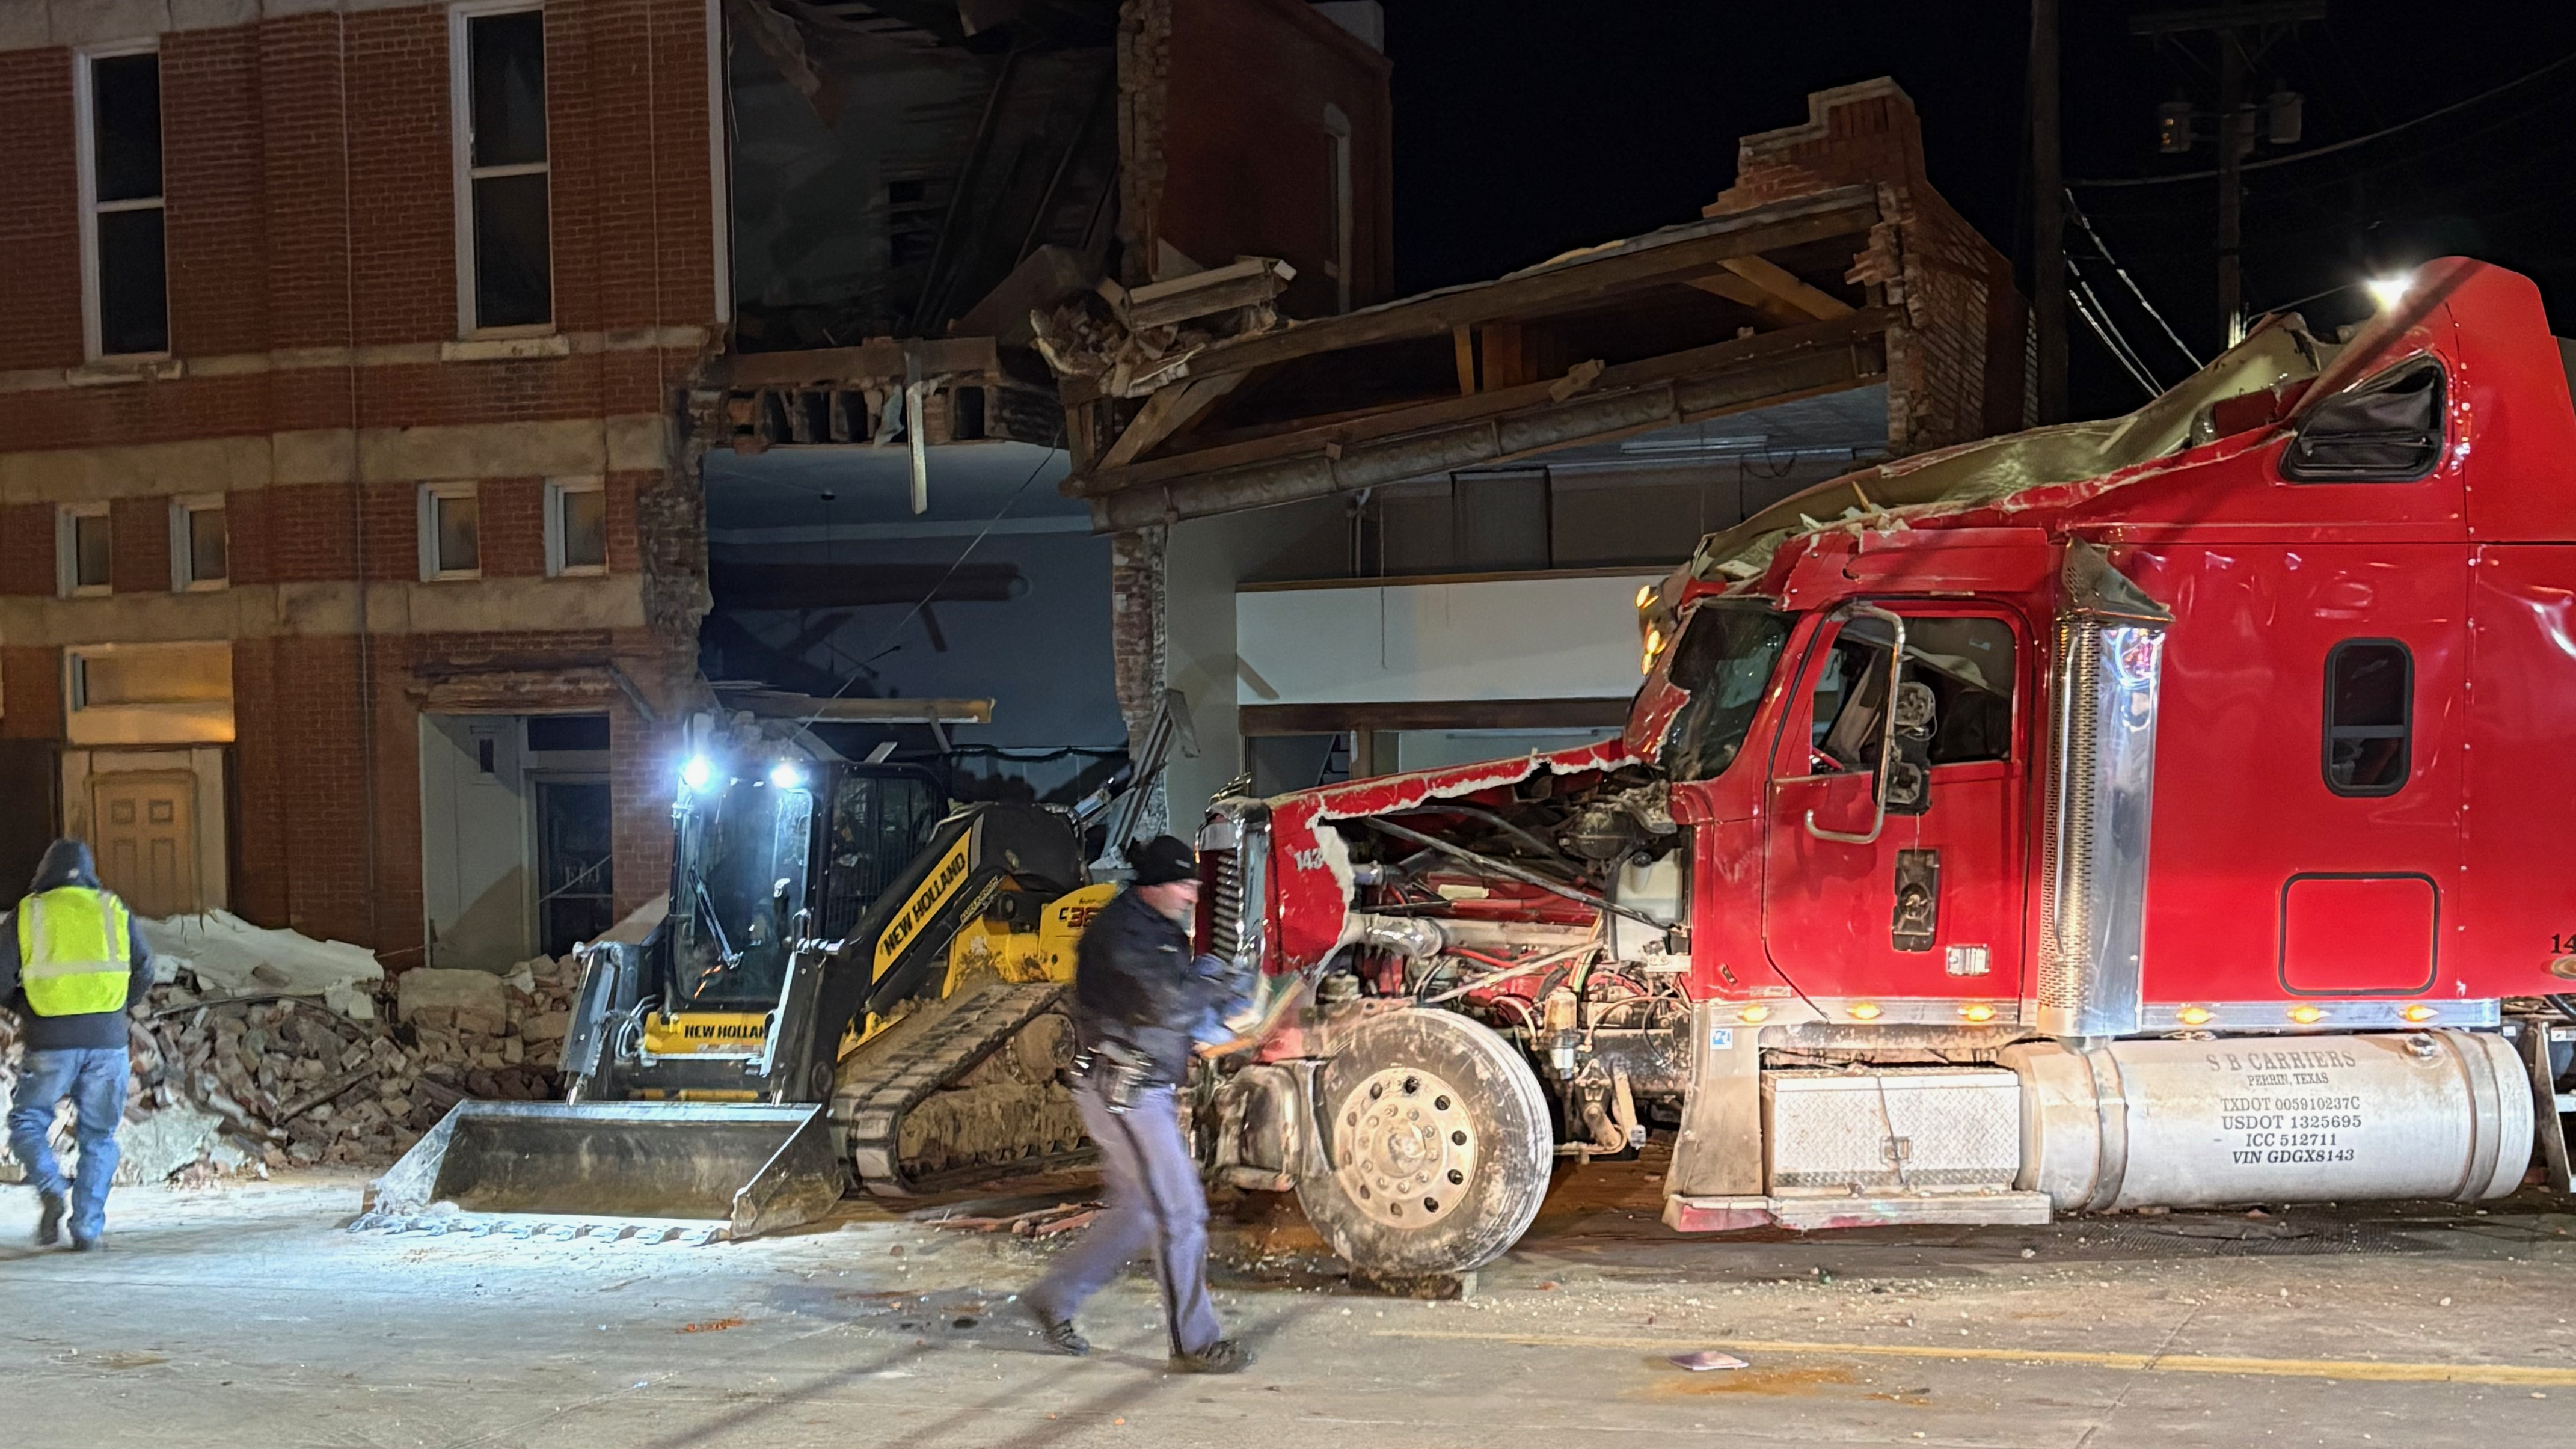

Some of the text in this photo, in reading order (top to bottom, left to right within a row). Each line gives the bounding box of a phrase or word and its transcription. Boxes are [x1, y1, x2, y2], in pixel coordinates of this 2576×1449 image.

[883, 852, 966, 957] NEW HOLLAND
[684, 1025, 765, 1038] NEW HOLLAN
[2206, 1050, 2356, 1071] S B CARRIERS
[2247, 1072, 2329, 1086] PERRIN, TEXAS
[2221, 1096, 2360, 1112] TXDOT 005910237C
[2221, 1115, 2361, 1130] USDOT 1325695
[2246, 1133, 2337, 1147] ICC 512711
[2233, 1149, 2354, 1164] VIN GDGX8143
